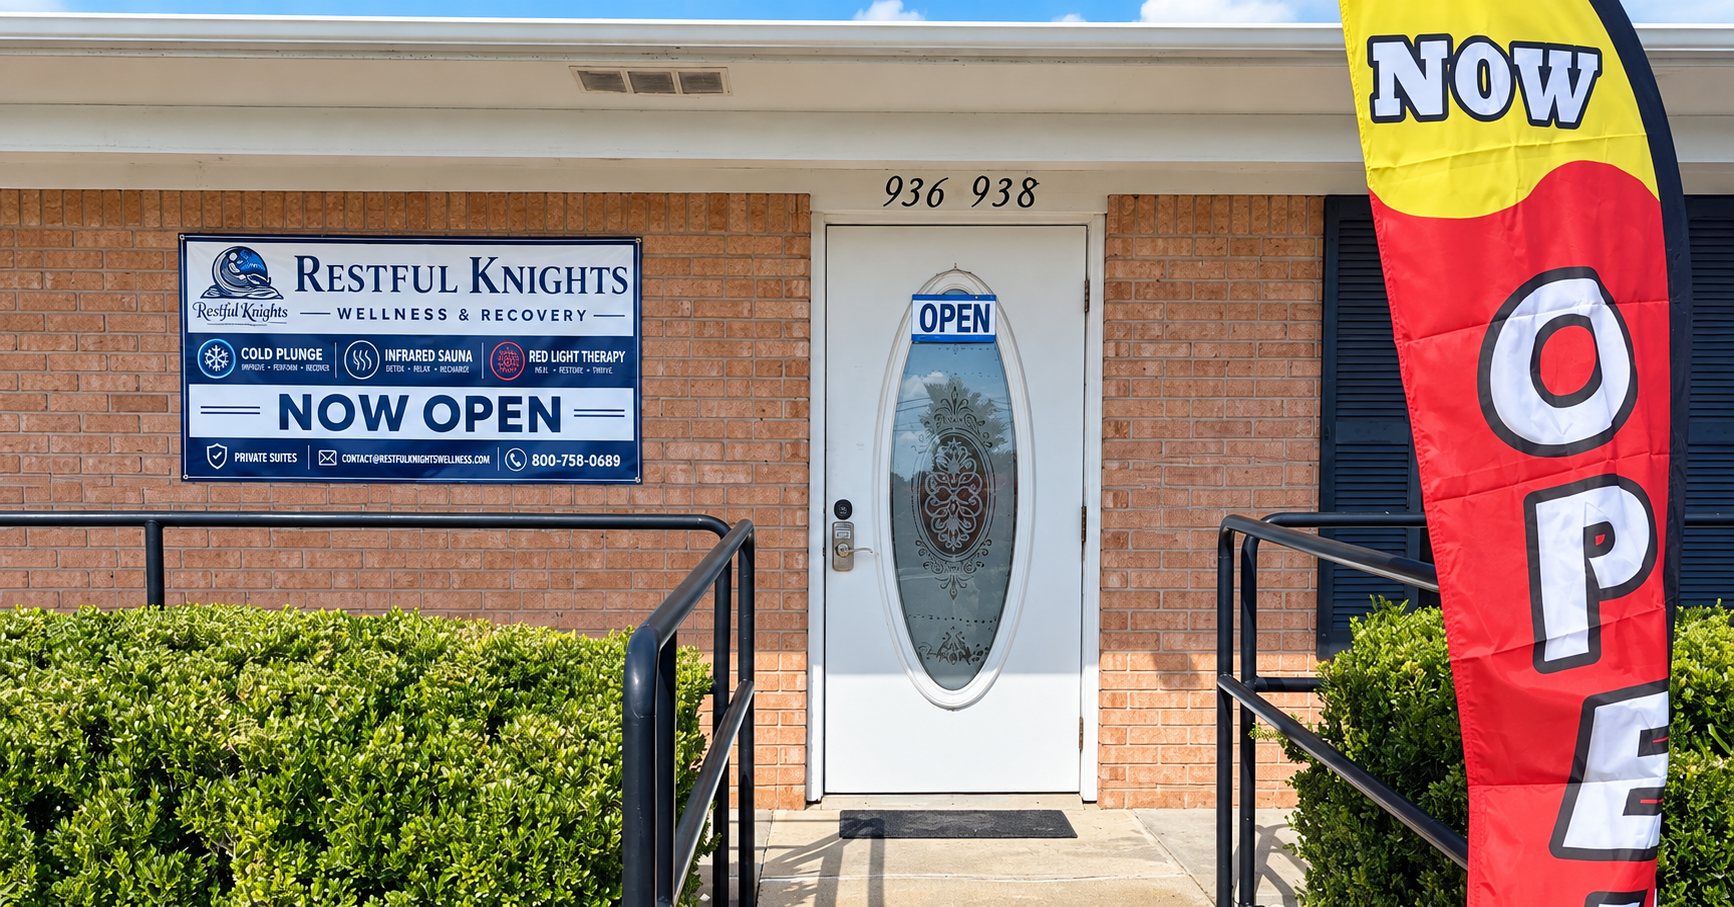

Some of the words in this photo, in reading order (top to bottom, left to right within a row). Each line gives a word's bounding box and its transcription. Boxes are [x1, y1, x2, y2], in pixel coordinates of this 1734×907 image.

[1368, 34, 1602, 130] NOW
[883, 175, 949, 208] 936
[971, 175, 1040, 208] 938
[294, 255, 458, 293] RESTFUL
[469, 256, 628, 294] KNIGHTS
[192, 302, 239, 321] Restful
[241, 302, 288, 322] Knights
[337, 307, 447, 321] WELLNESS
[458, 308, 469, 321] &
[481, 309, 587, 322] RECOVERY
[919, 303, 990, 333] OPEN
[241, 347, 273, 360] COLD
[276, 348, 323, 361] PLUNGE
[385, 349, 435, 362] INFRARED
[438, 349, 473, 362] SAUNA
[529, 350, 548, 362] RED
[551, 350, 579, 363] LIGHT
[581, 351, 626, 363] THERAPY
[279, 393, 410, 431] NOW
[423, 394, 561, 433] OPEN
[234, 452, 268, 463] PRIVATE
[269, 452, 297, 463] SUITES
[341, 453, 490, 465] CONTACT@RESTFULKNIGHTSWELLNESS.COM
[531, 453, 621, 467] 800-758-0689
[1477, 266, 1669, 907] OPE
